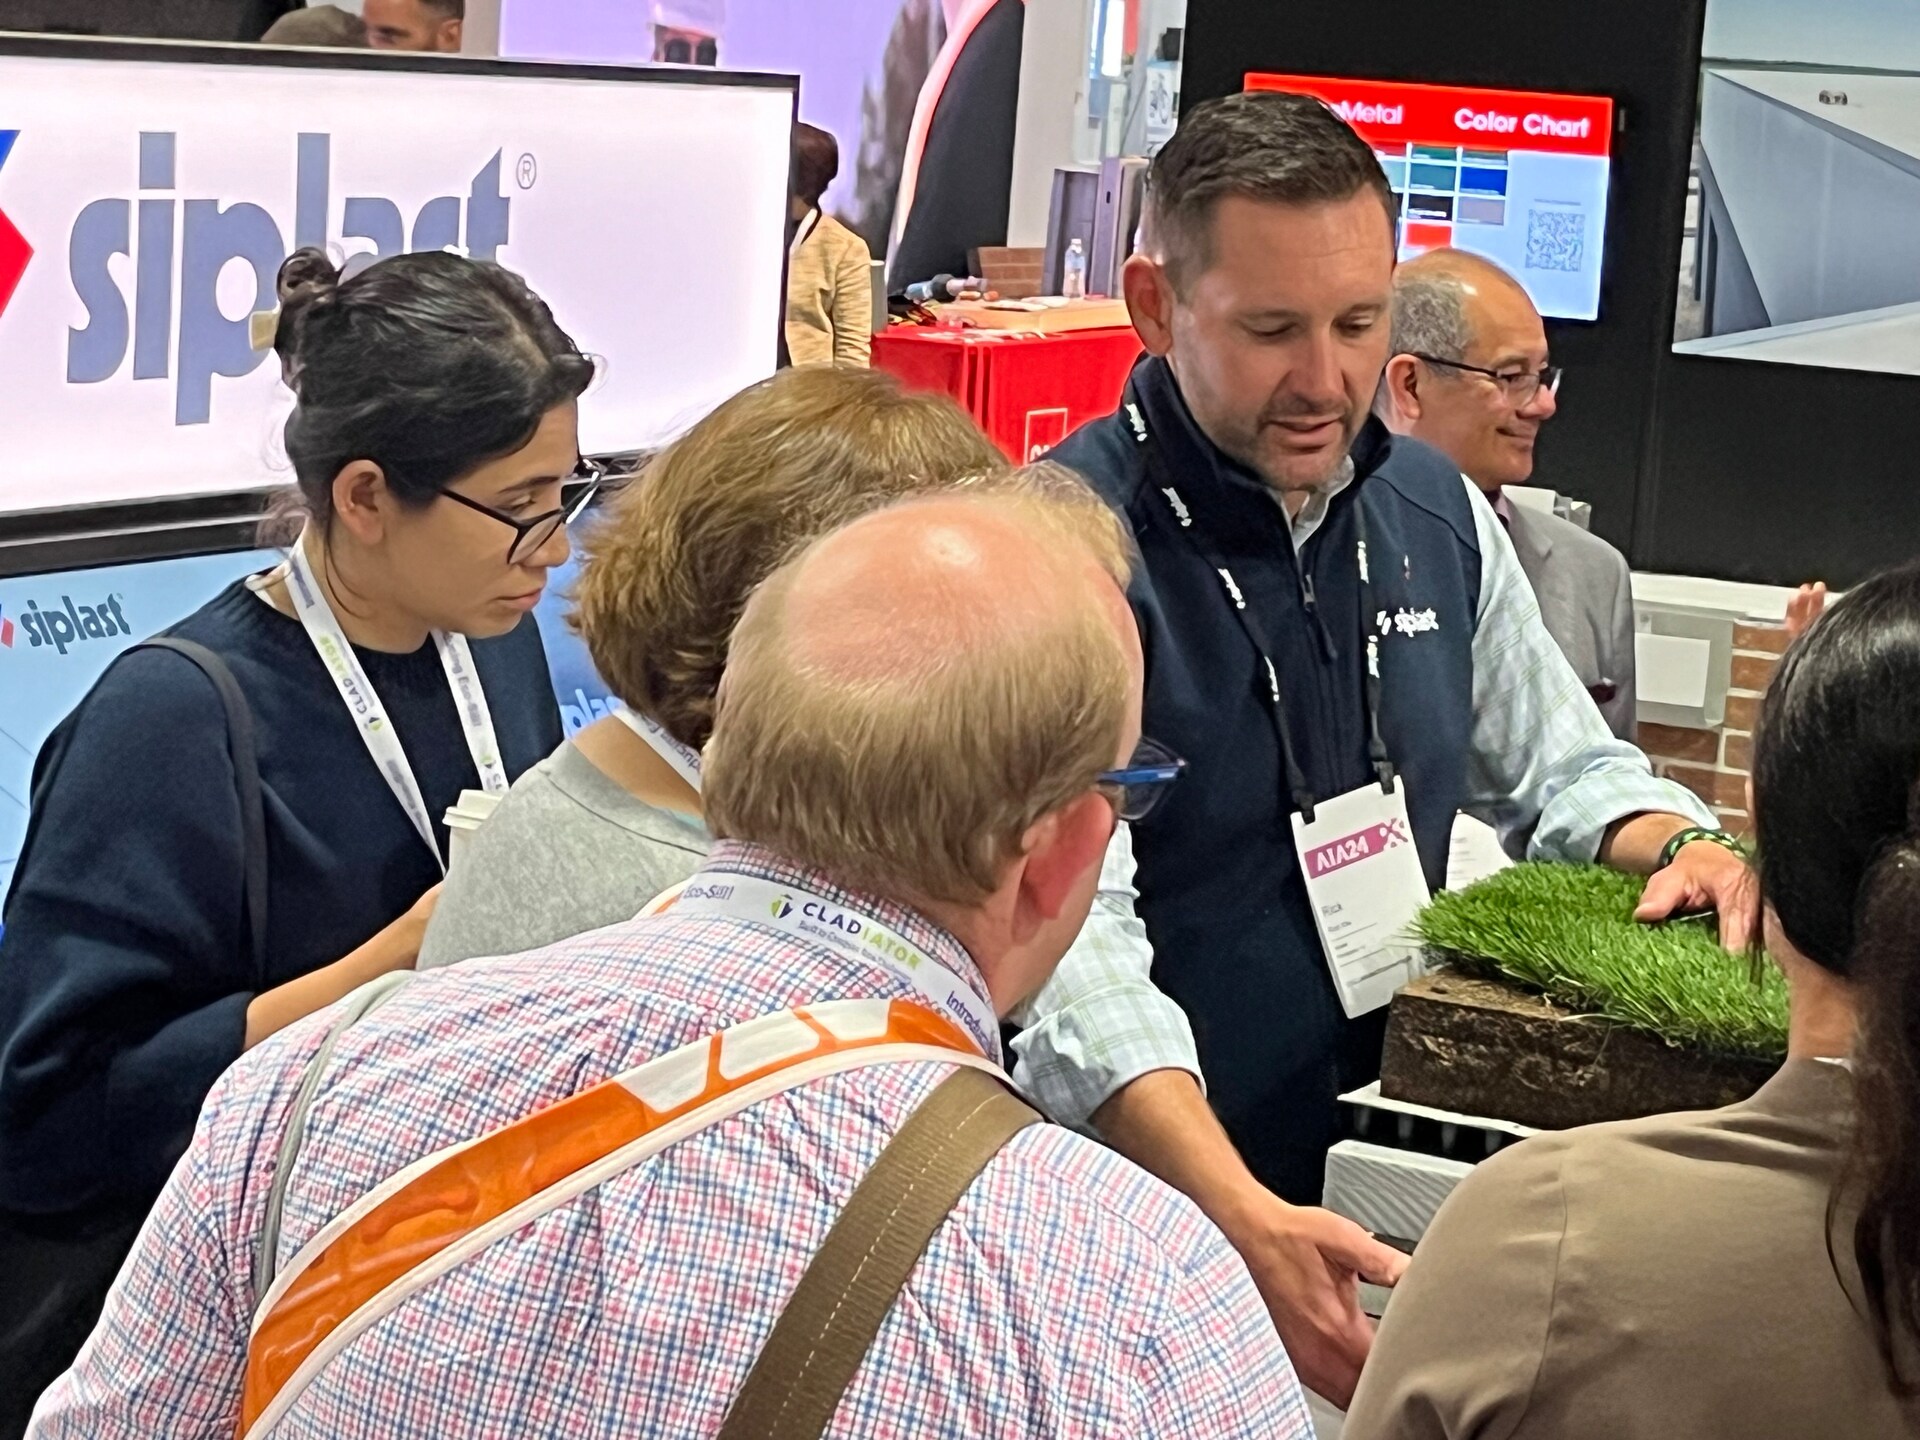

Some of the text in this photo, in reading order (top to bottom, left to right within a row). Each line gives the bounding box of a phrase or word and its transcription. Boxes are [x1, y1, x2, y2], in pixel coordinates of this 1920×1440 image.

[1455, 108, 1590, 138] Color Chart
[20, 593, 131, 654] siplast
[1317, 835, 1370, 871] AIA24
[802, 902, 921, 970] CLADIATOR
